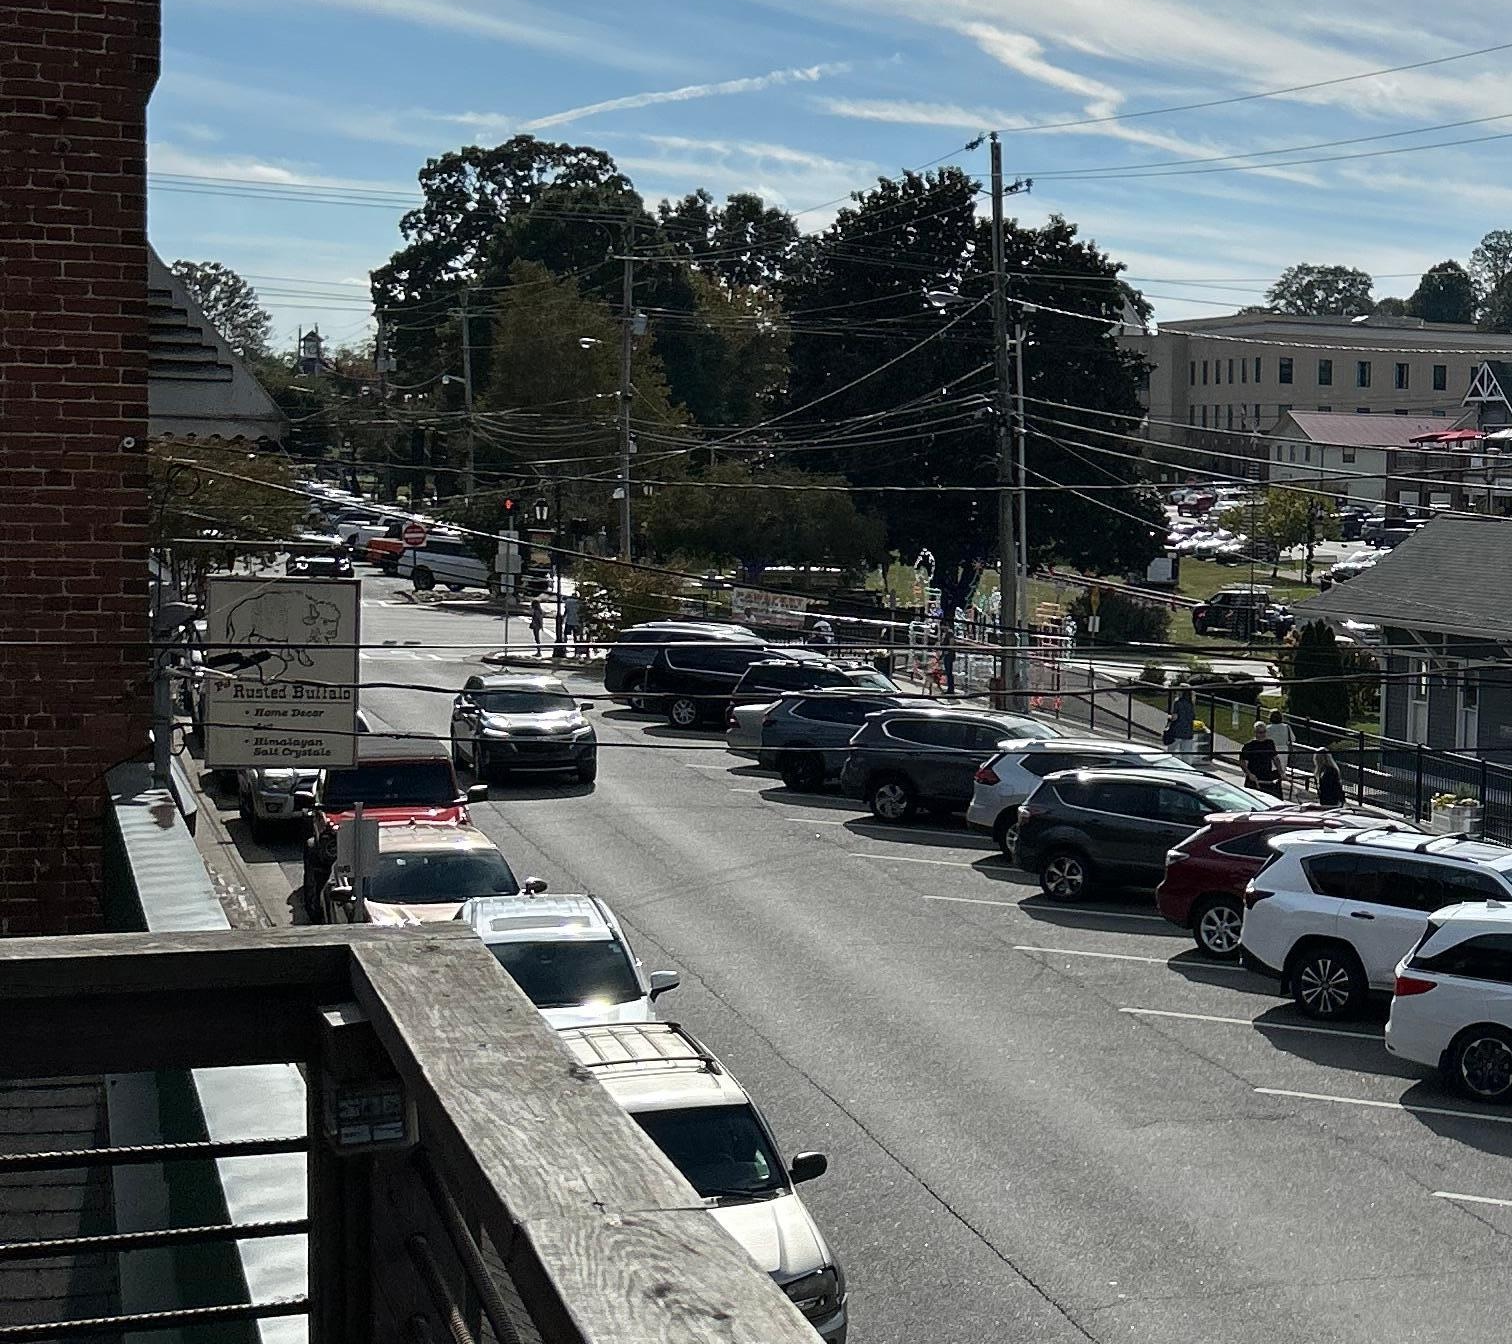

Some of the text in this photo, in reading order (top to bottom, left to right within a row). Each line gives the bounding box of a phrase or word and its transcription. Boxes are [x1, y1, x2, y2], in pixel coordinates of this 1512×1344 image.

[233, 684, 287, 699] Rusted
[254, 708, 289, 717] Home
[253, 737, 324, 749] Himalayan
[253, 747, 280, 757] Salt
